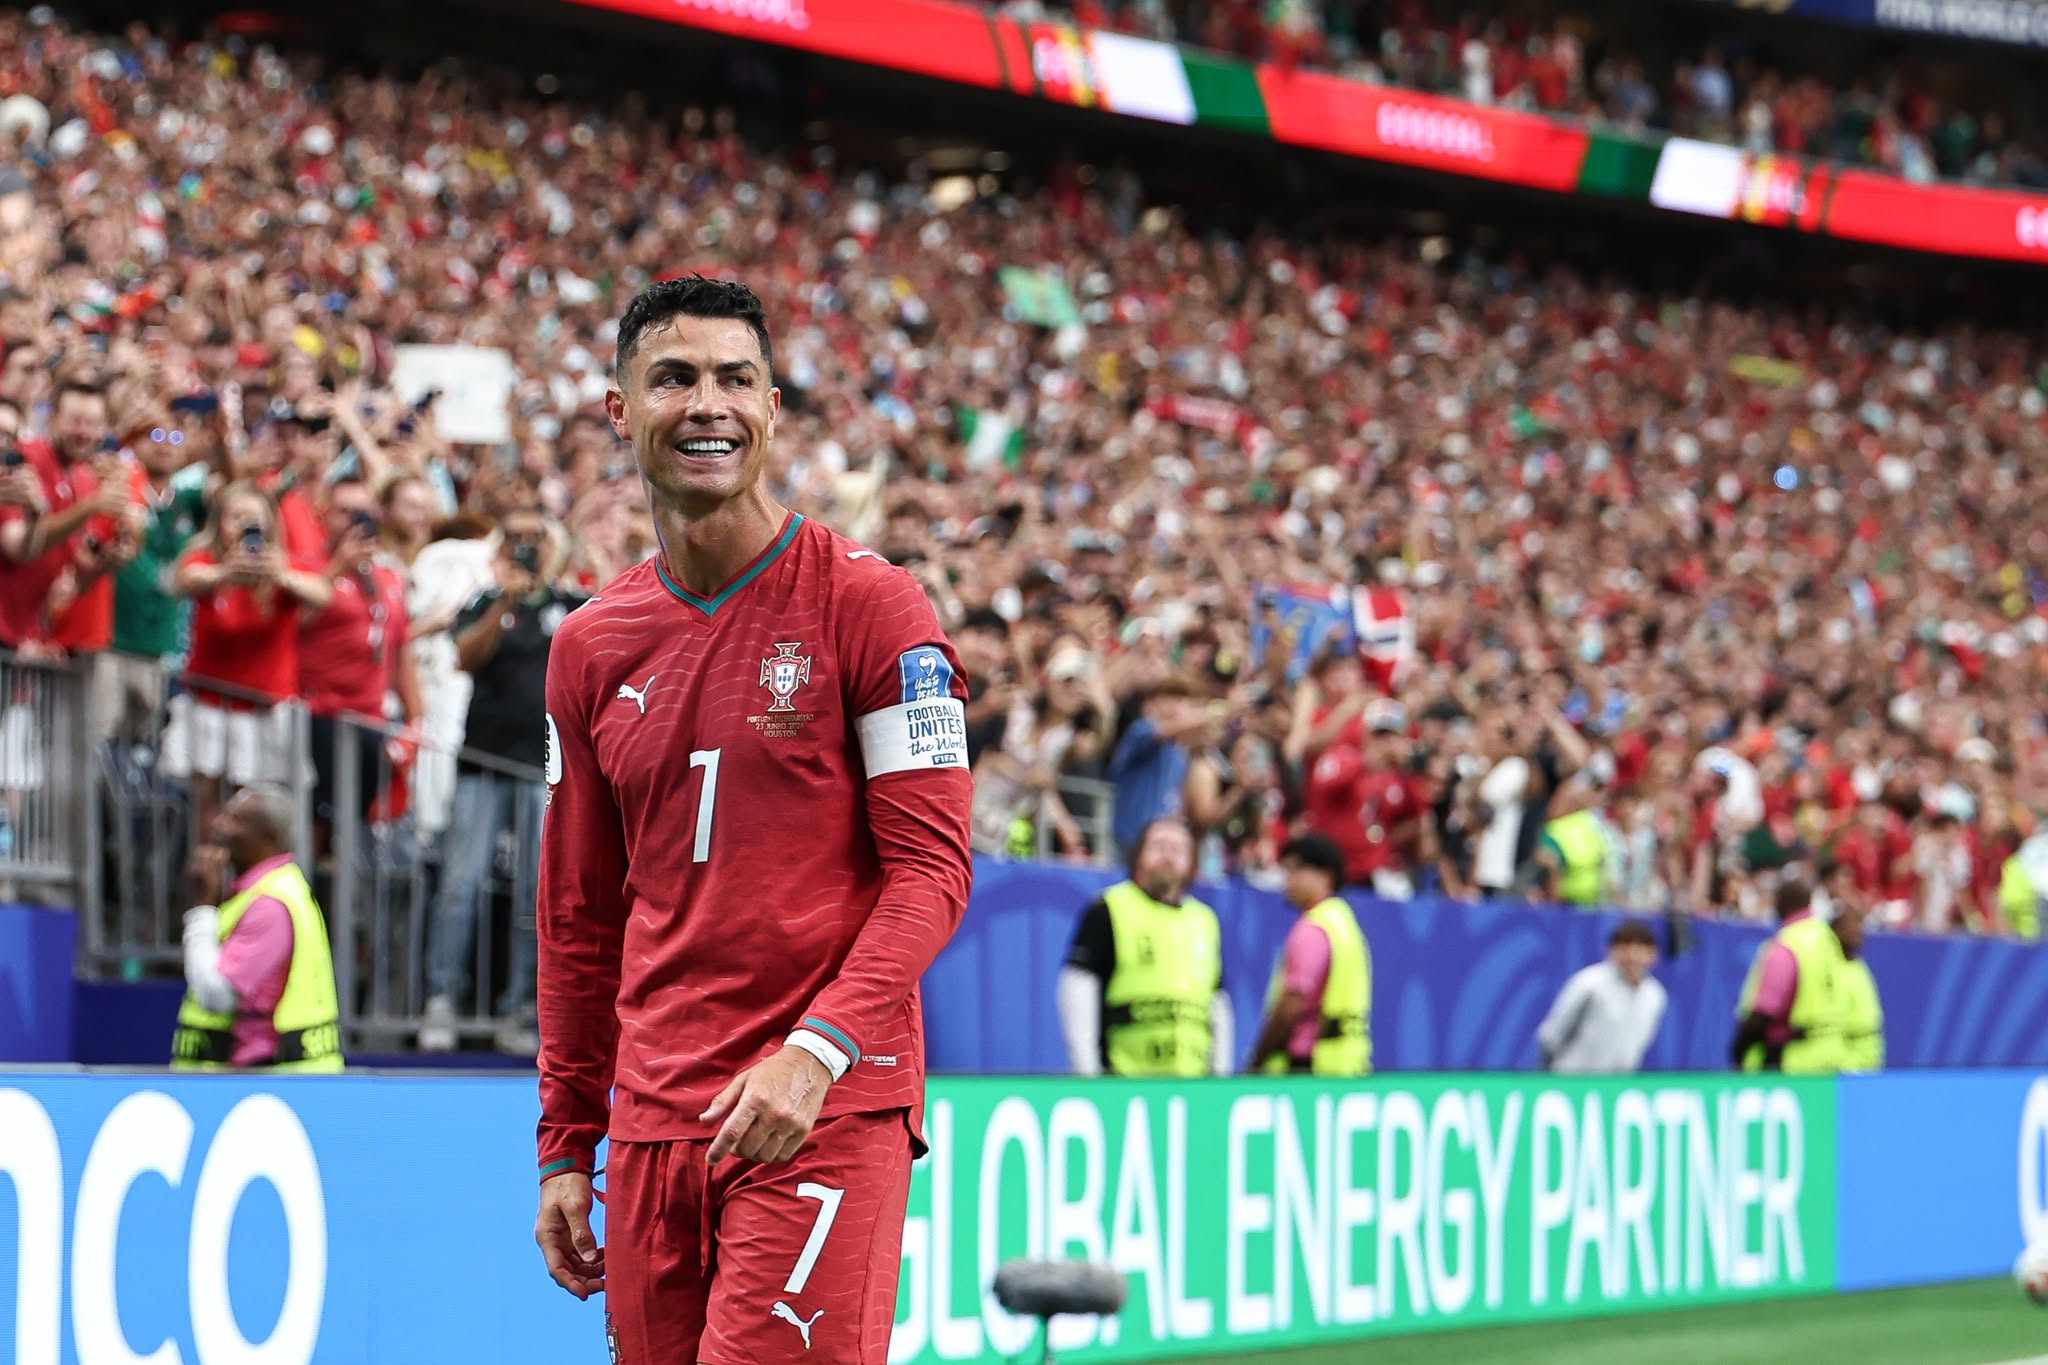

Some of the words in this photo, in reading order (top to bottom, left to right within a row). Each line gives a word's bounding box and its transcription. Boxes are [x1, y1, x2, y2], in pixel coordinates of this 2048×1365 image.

[907, 705, 960, 722] FOOTBALL
[755, 722, 764, 730] 23
[909, 718, 963, 739] UNITES
[907, 741, 934, 756] the
[934, 754, 956, 764] FIFA
[1227, 1089, 1524, 1334] ENERGY
[1530, 1088, 1806, 1307] PARTNER
[783, 1181, 846, 1295] 7
